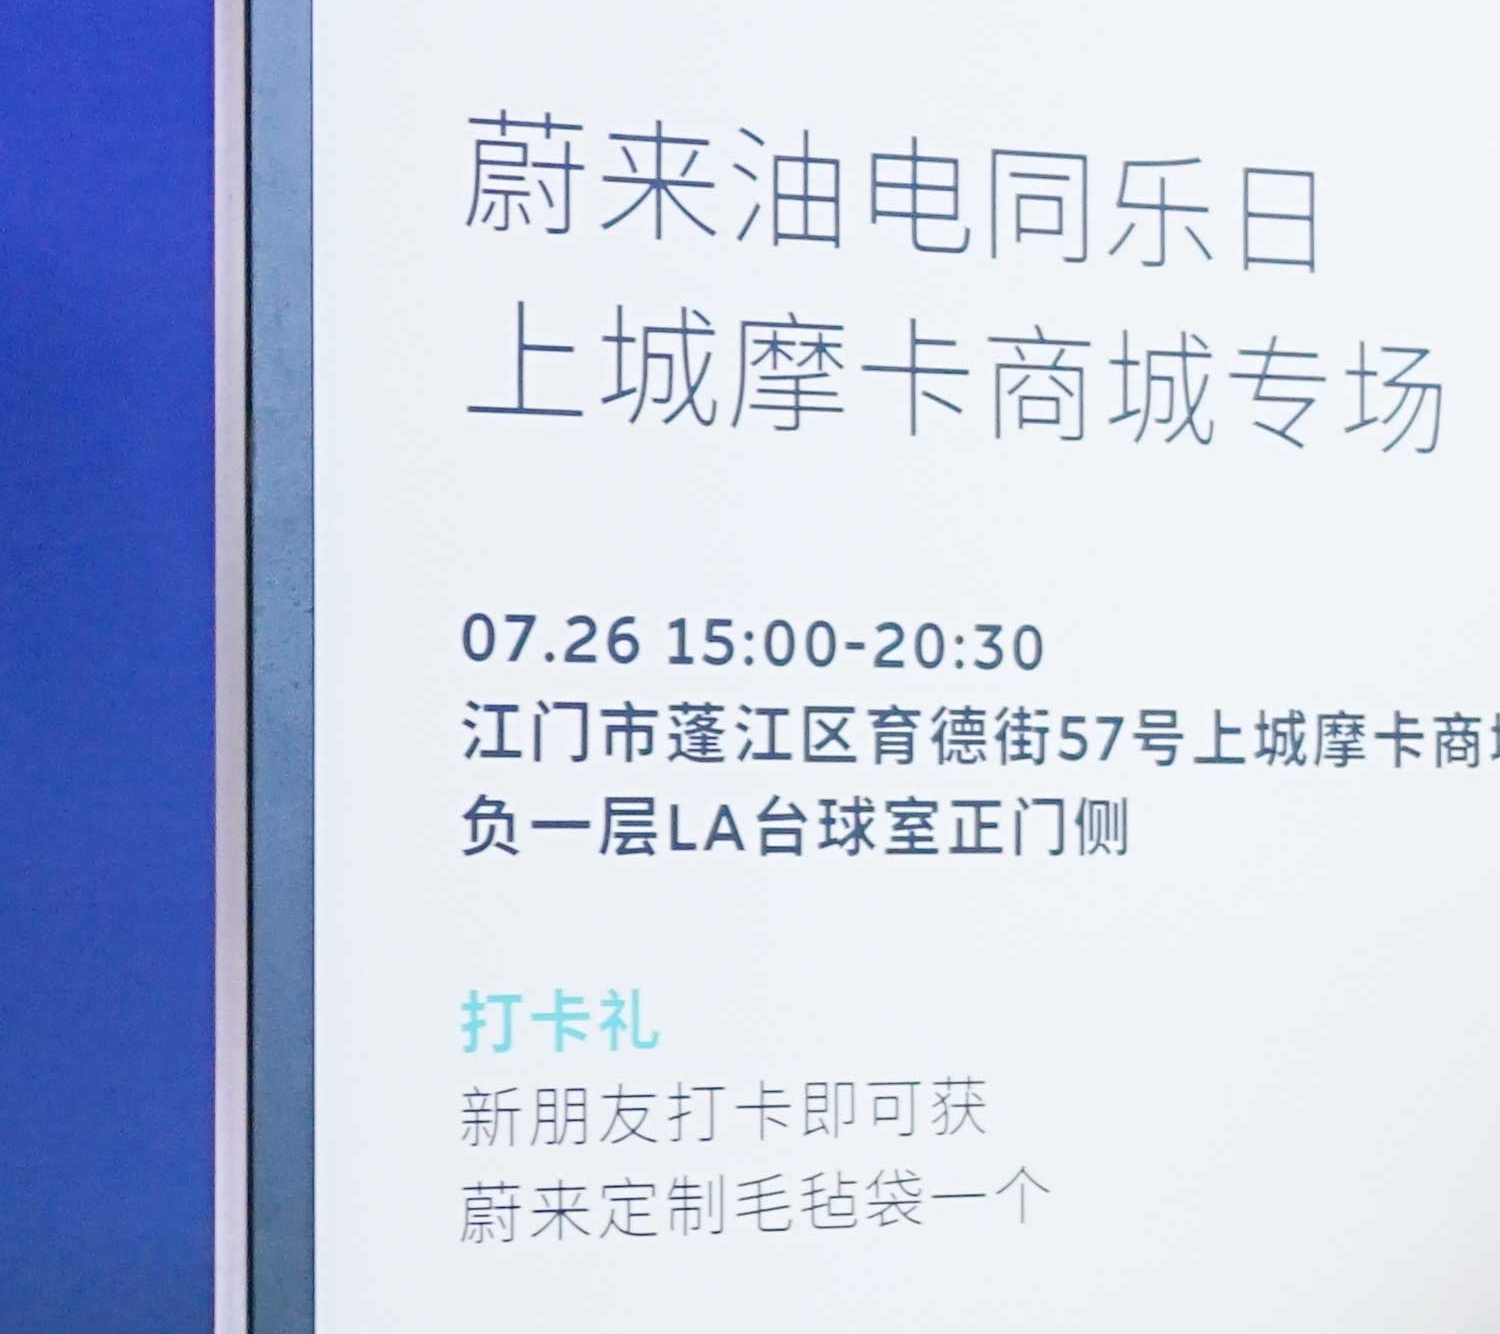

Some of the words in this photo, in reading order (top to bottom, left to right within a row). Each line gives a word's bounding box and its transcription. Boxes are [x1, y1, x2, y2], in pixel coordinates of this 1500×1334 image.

[465, 108, 1315, 273] 蔚来油电同乐日
[466, 300, 1442, 454] 上城摩卡商城专场
[462, 612, 640, 664] 07.26
[668, 617, 1043, 671] 15:00-20:30
[461, 794, 1128, 857] 负一层LA台球室正门侧
[460, 988, 660, 1053] 打卡礼
[461, 1076, 986, 1147] 新朋友打卡即可获
[461, 1166, 1050, 1244] 蔚来定制毛毡袋一个
